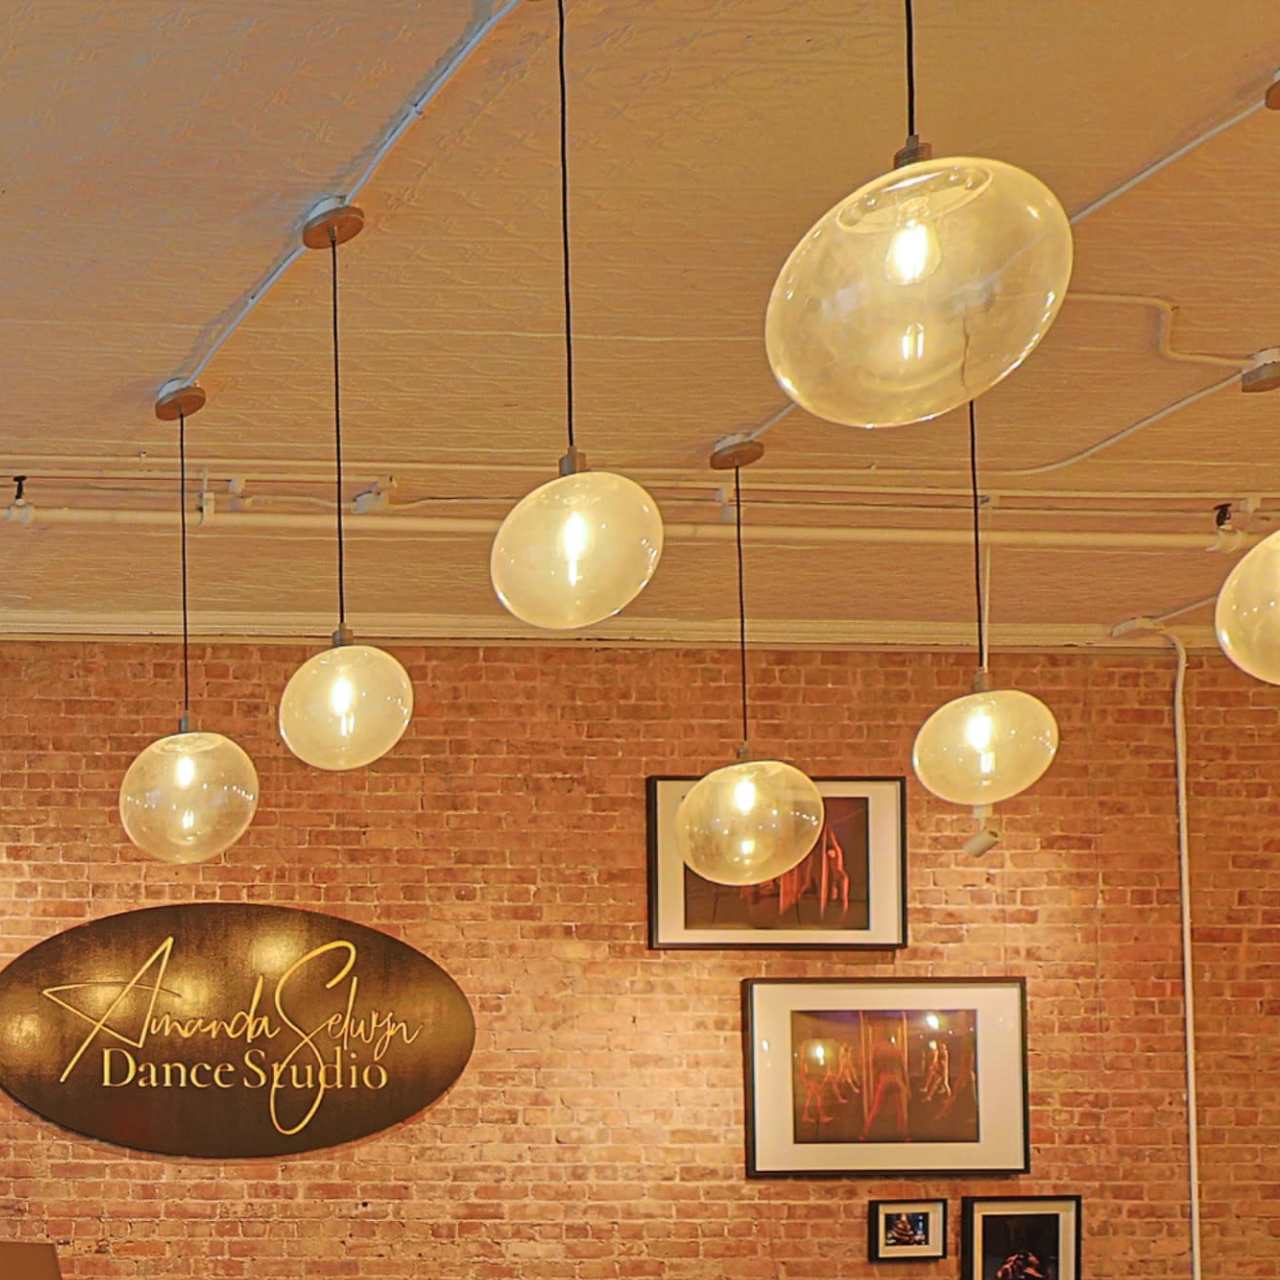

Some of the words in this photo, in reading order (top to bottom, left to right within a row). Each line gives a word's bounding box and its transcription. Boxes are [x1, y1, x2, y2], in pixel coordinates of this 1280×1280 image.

[42, 936, 279, 1084] Amanda
[270, 940, 423, 1136] Selwyn
[101, 1047, 236, 1089] Dance
[243, 1046, 389, 1090] Studio
